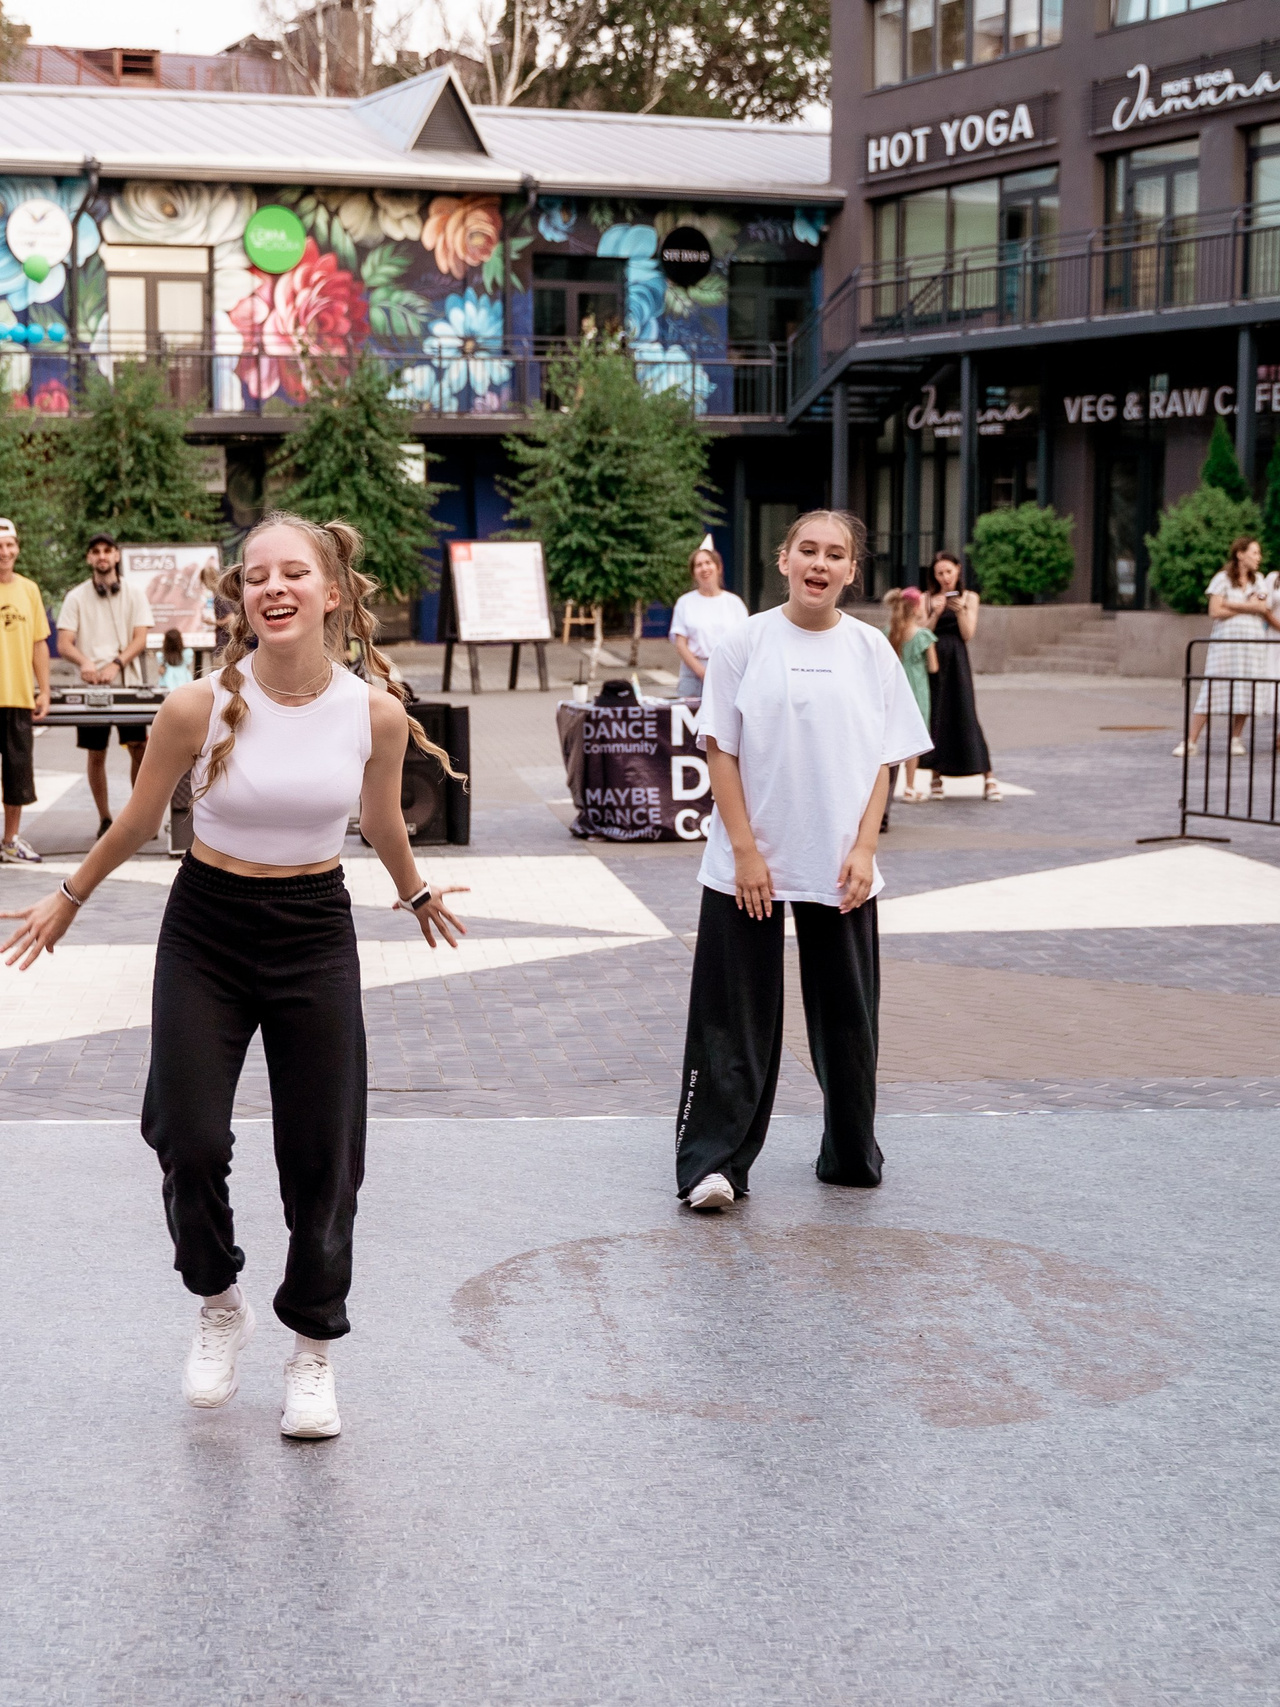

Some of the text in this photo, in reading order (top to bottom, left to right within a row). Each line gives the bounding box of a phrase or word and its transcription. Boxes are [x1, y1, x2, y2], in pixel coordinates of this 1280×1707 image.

[1161, 68, 1234, 97] HOT YOGA
[867, 103, 1035, 173] HOT YOGA
[1064, 382, 1280, 424] VEG & RAW CFE
[583, 721, 658, 739] DANCE
[583, 740, 658, 755] Community
[585, 787, 661, 806] MAYBE
[587, 807, 662, 826] DANCE
[689, 1069, 698, 1087] MDC
[682, 1090, 694, 1120] BLACK
